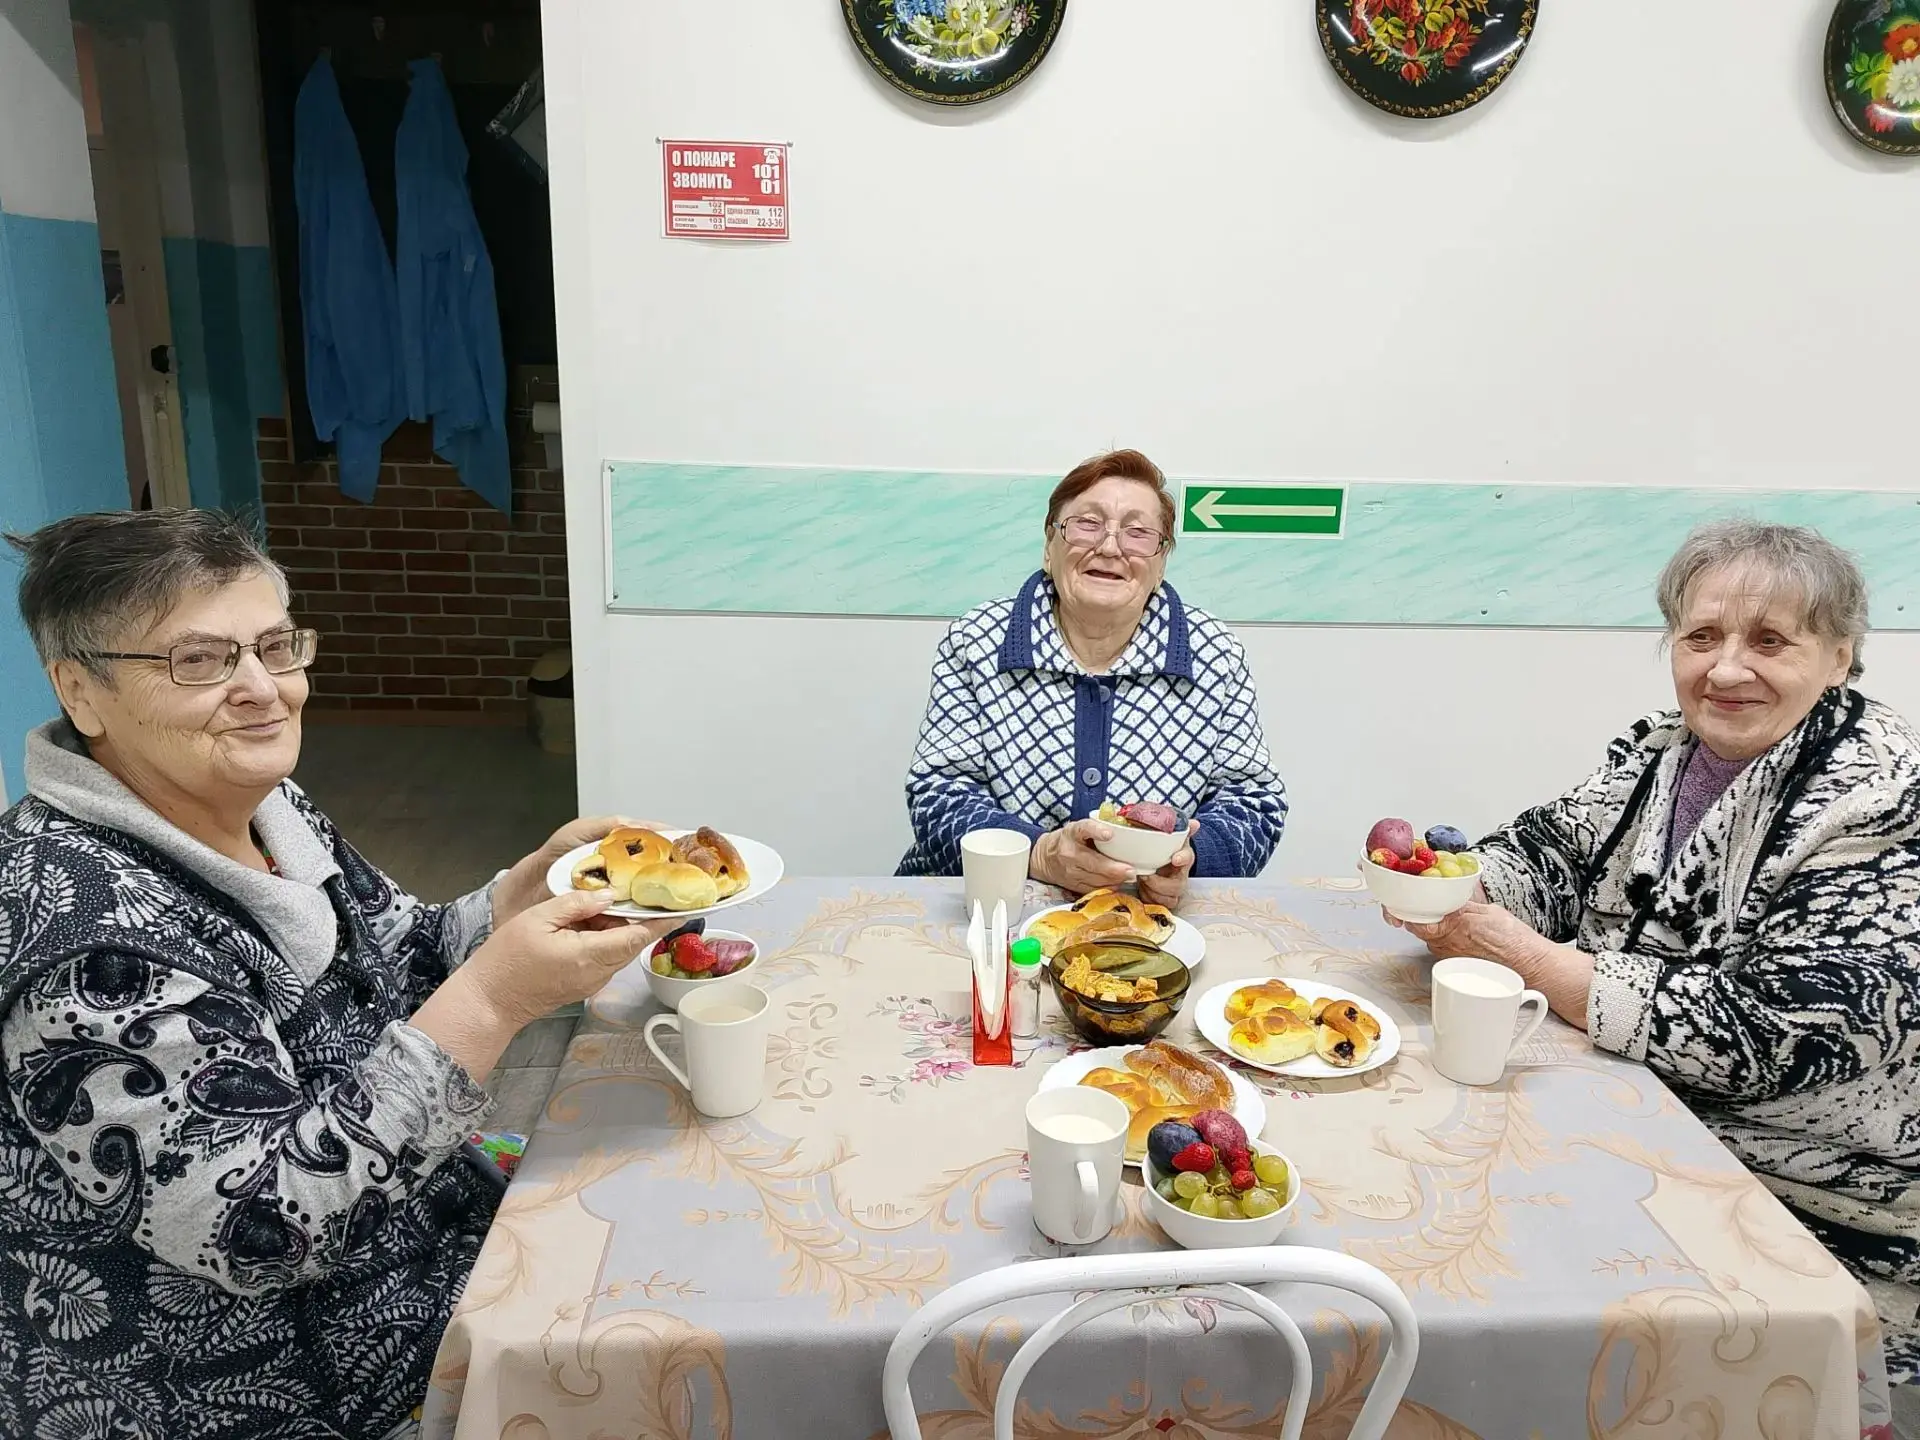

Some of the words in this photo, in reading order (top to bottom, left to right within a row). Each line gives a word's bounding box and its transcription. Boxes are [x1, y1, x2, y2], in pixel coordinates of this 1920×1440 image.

[672, 151, 681, 167] О
[683, 151, 736, 168] ПОЖАРЕ
[752, 164, 780, 179] 101
[672, 172, 732, 189] ЗВОНИТЬ
[761, 179, 780, 194] 01
[768, 207, 783, 217] 112
